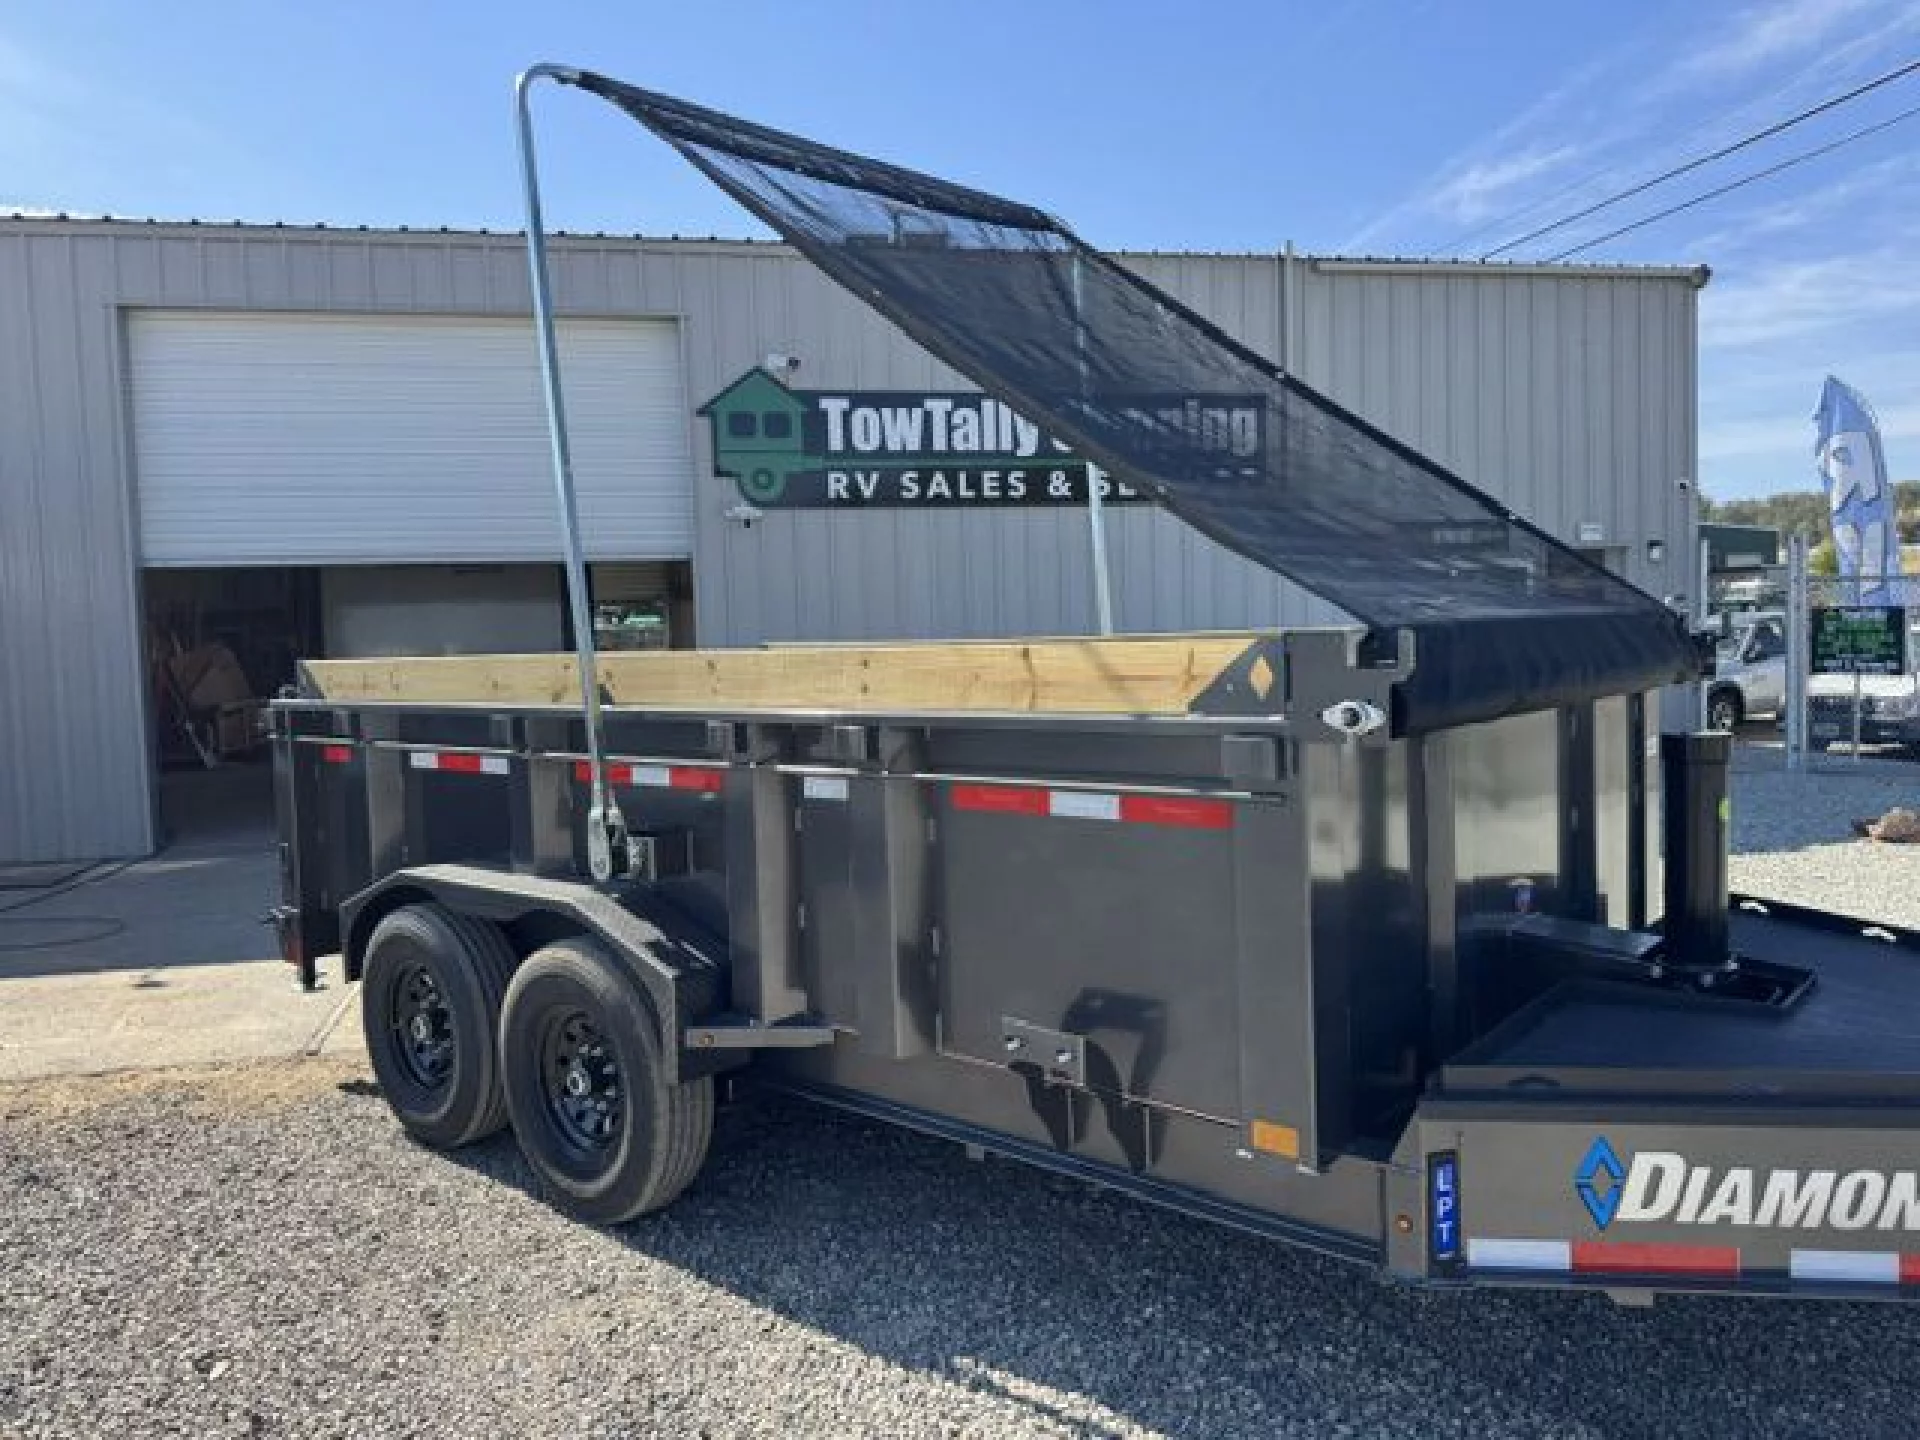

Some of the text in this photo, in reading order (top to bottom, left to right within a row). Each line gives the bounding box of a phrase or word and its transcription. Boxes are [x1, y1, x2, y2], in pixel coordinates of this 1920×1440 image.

[819, 398, 1039, 456] TowTally
[827, 470, 880, 499] RV
[900, 470, 1027, 499] SALES
[1048, 470, 1072, 498] &
